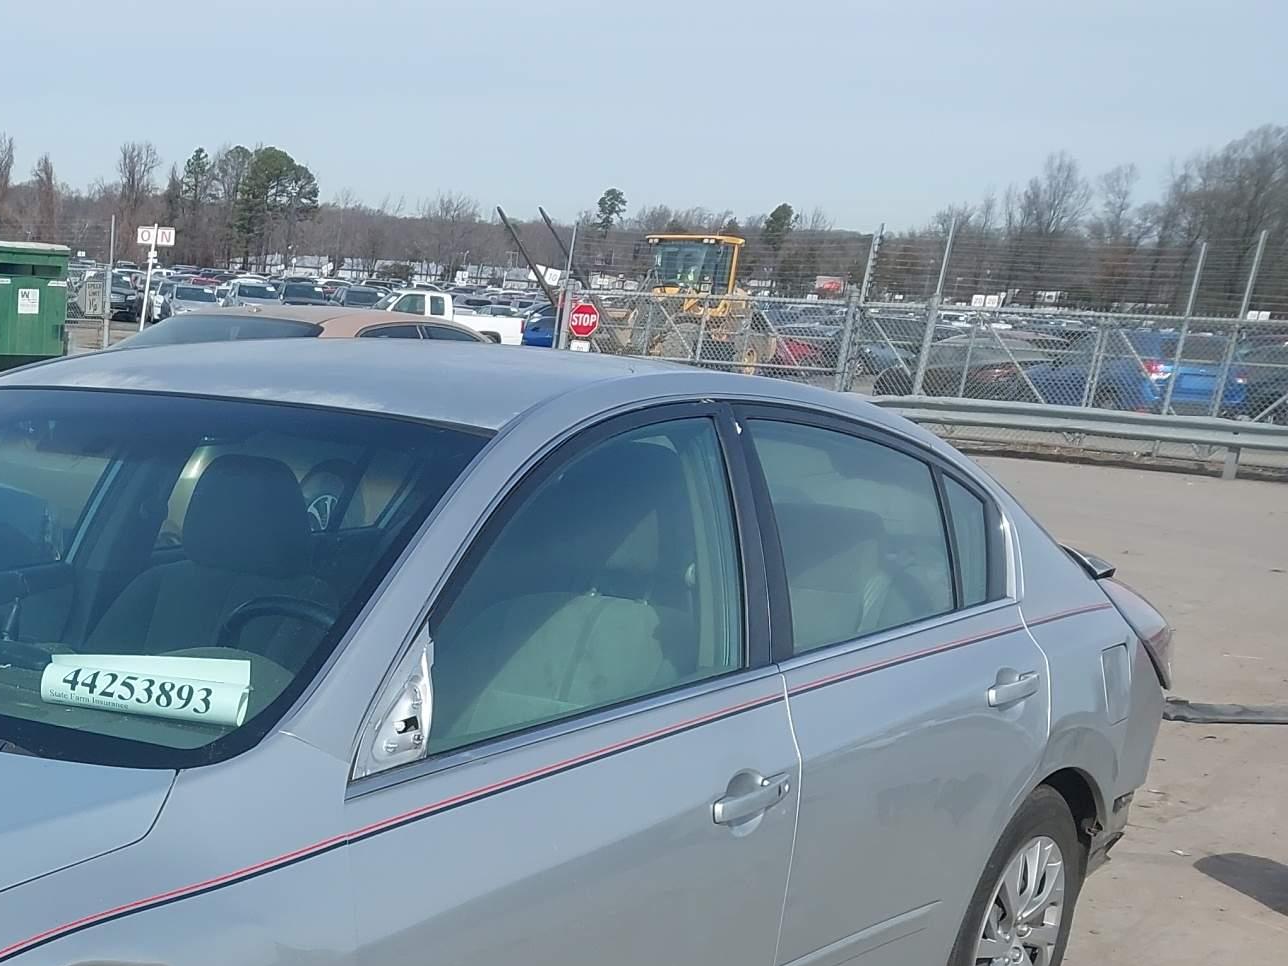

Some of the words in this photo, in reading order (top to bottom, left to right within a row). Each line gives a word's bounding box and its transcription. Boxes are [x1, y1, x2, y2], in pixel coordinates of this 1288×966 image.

[140, 229, 151, 242] O
[160, 230, 172, 243] N
[571, 313, 597, 327] STOP
[62, 667, 213, 714] 44253893
[49, 689, 68, 699] State
[70, 693, 90, 703] Farm
[92, 696, 129, 710] Insurance
